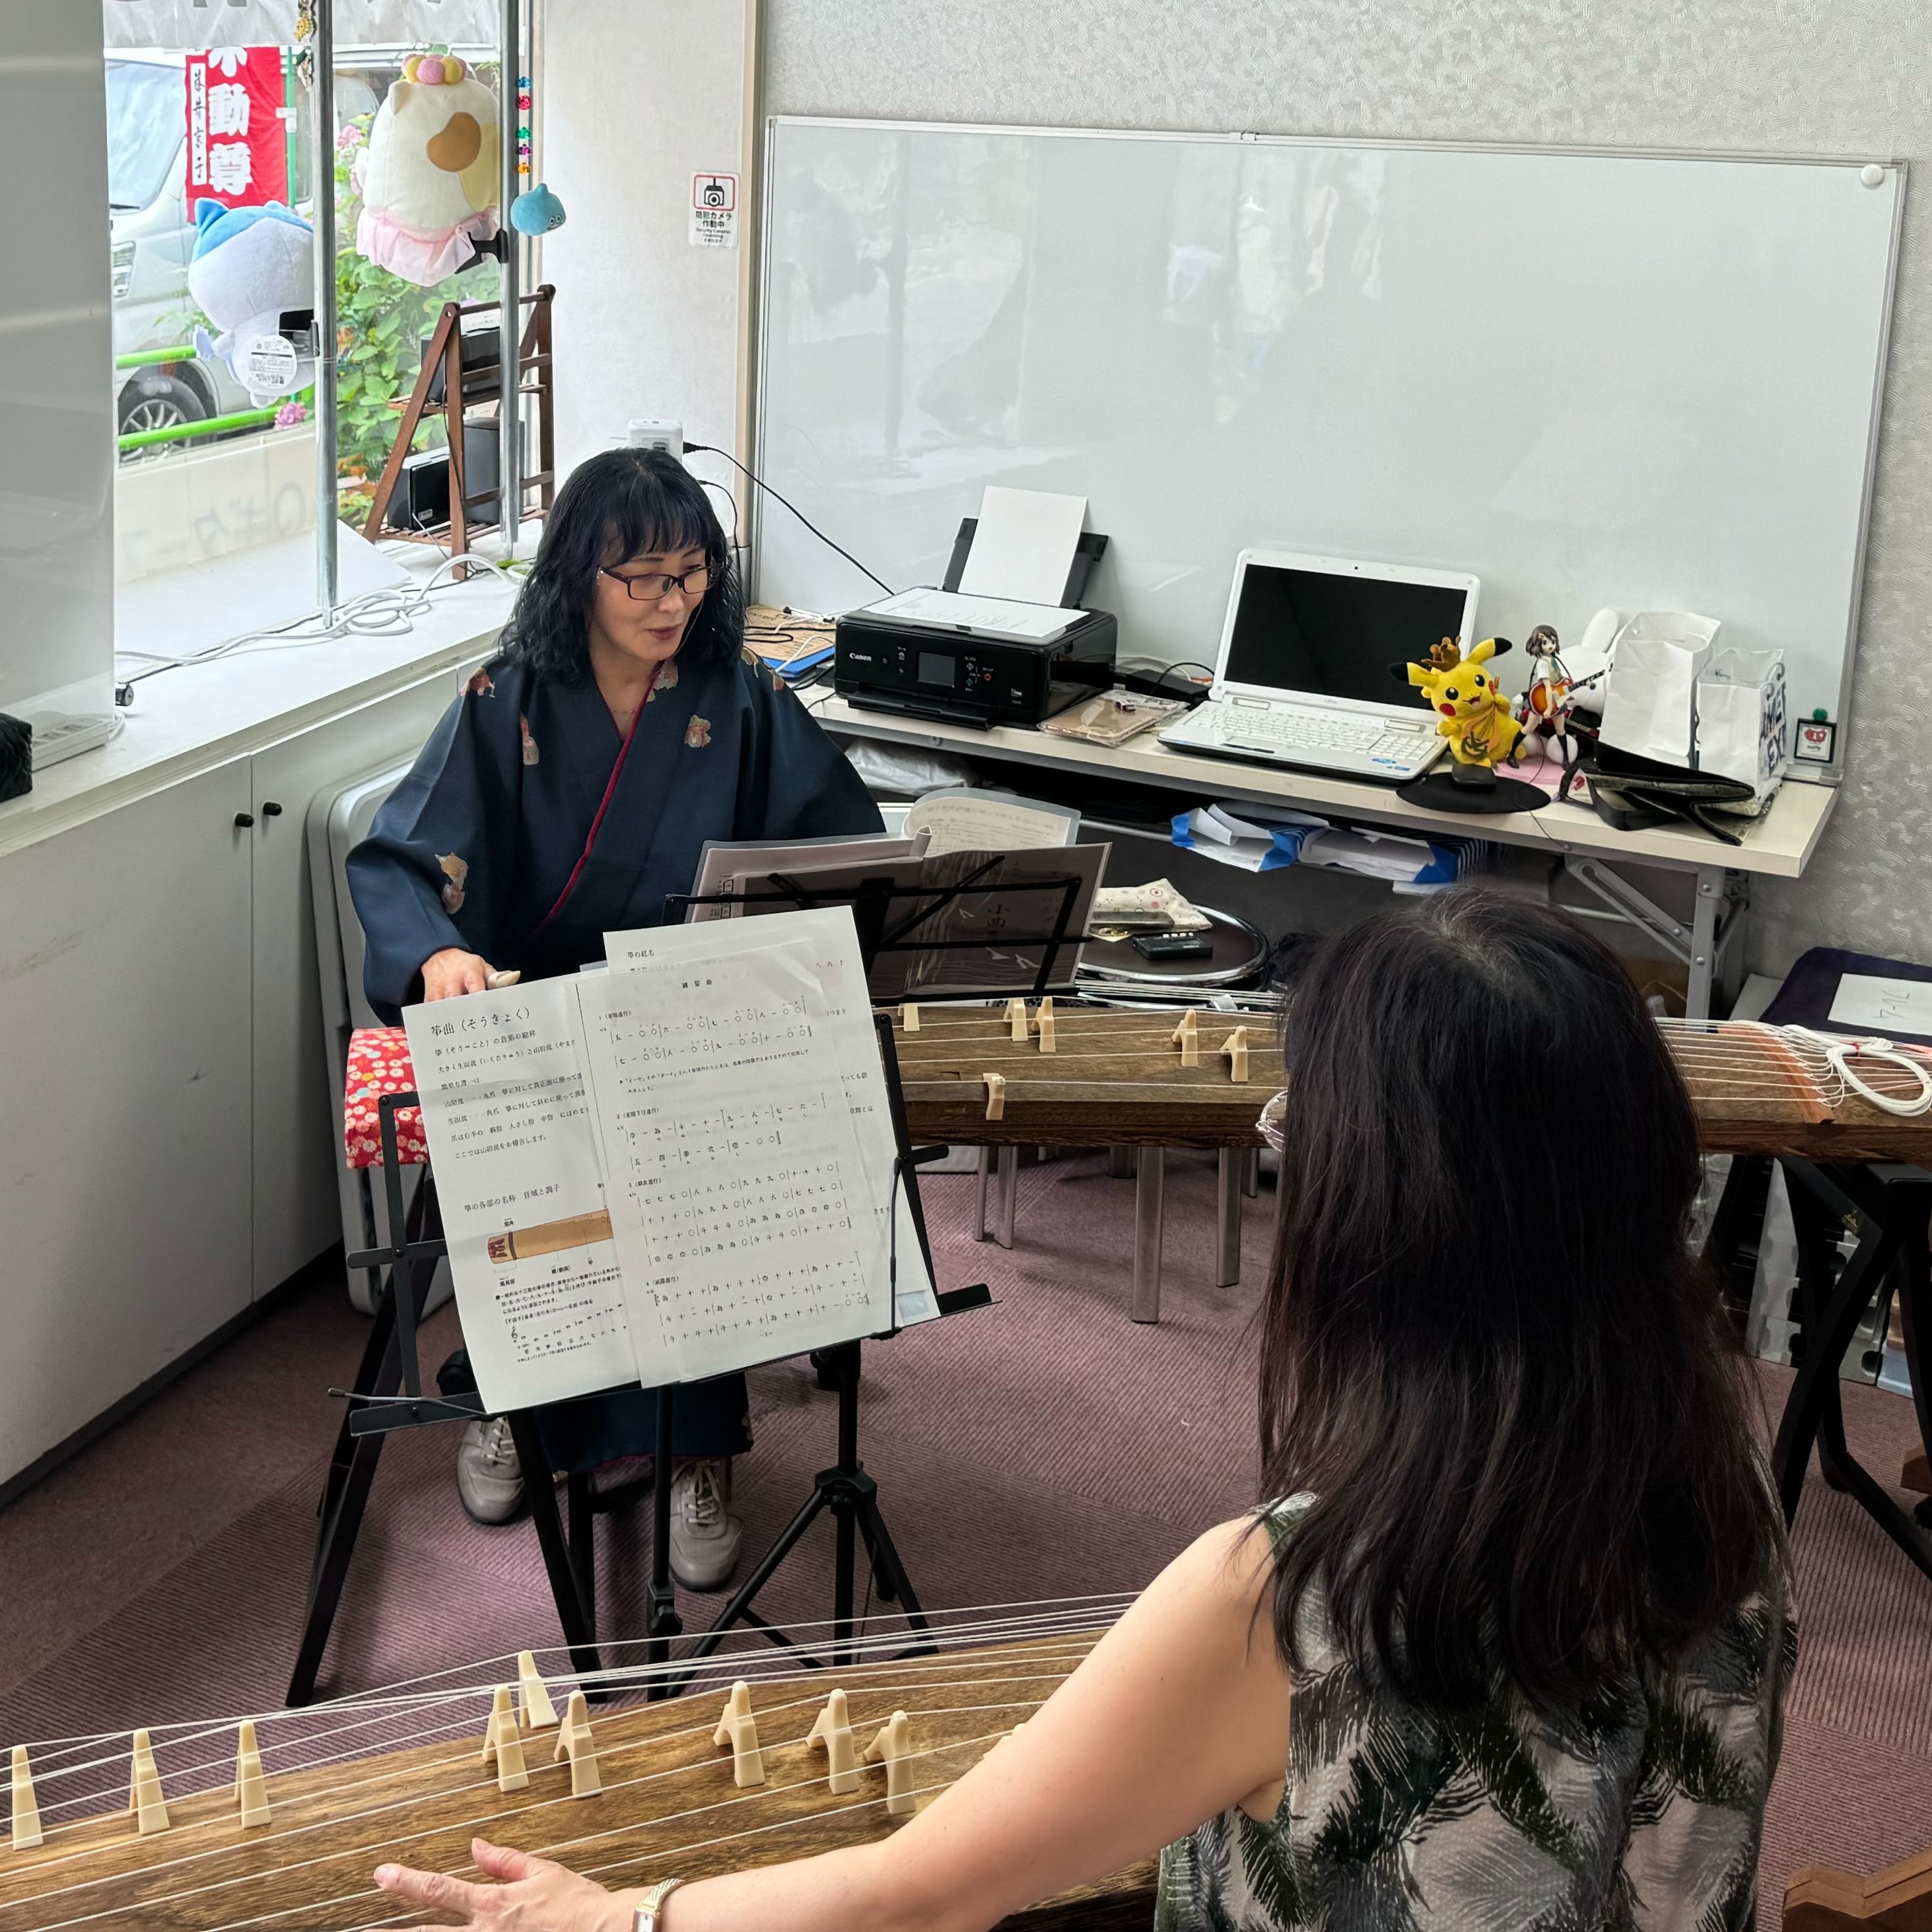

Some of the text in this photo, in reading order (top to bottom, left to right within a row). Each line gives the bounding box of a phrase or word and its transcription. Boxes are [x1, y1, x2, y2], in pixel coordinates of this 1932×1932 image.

[703, 220, 725, 228] 作動中
[849, 652, 872, 662] Canon
